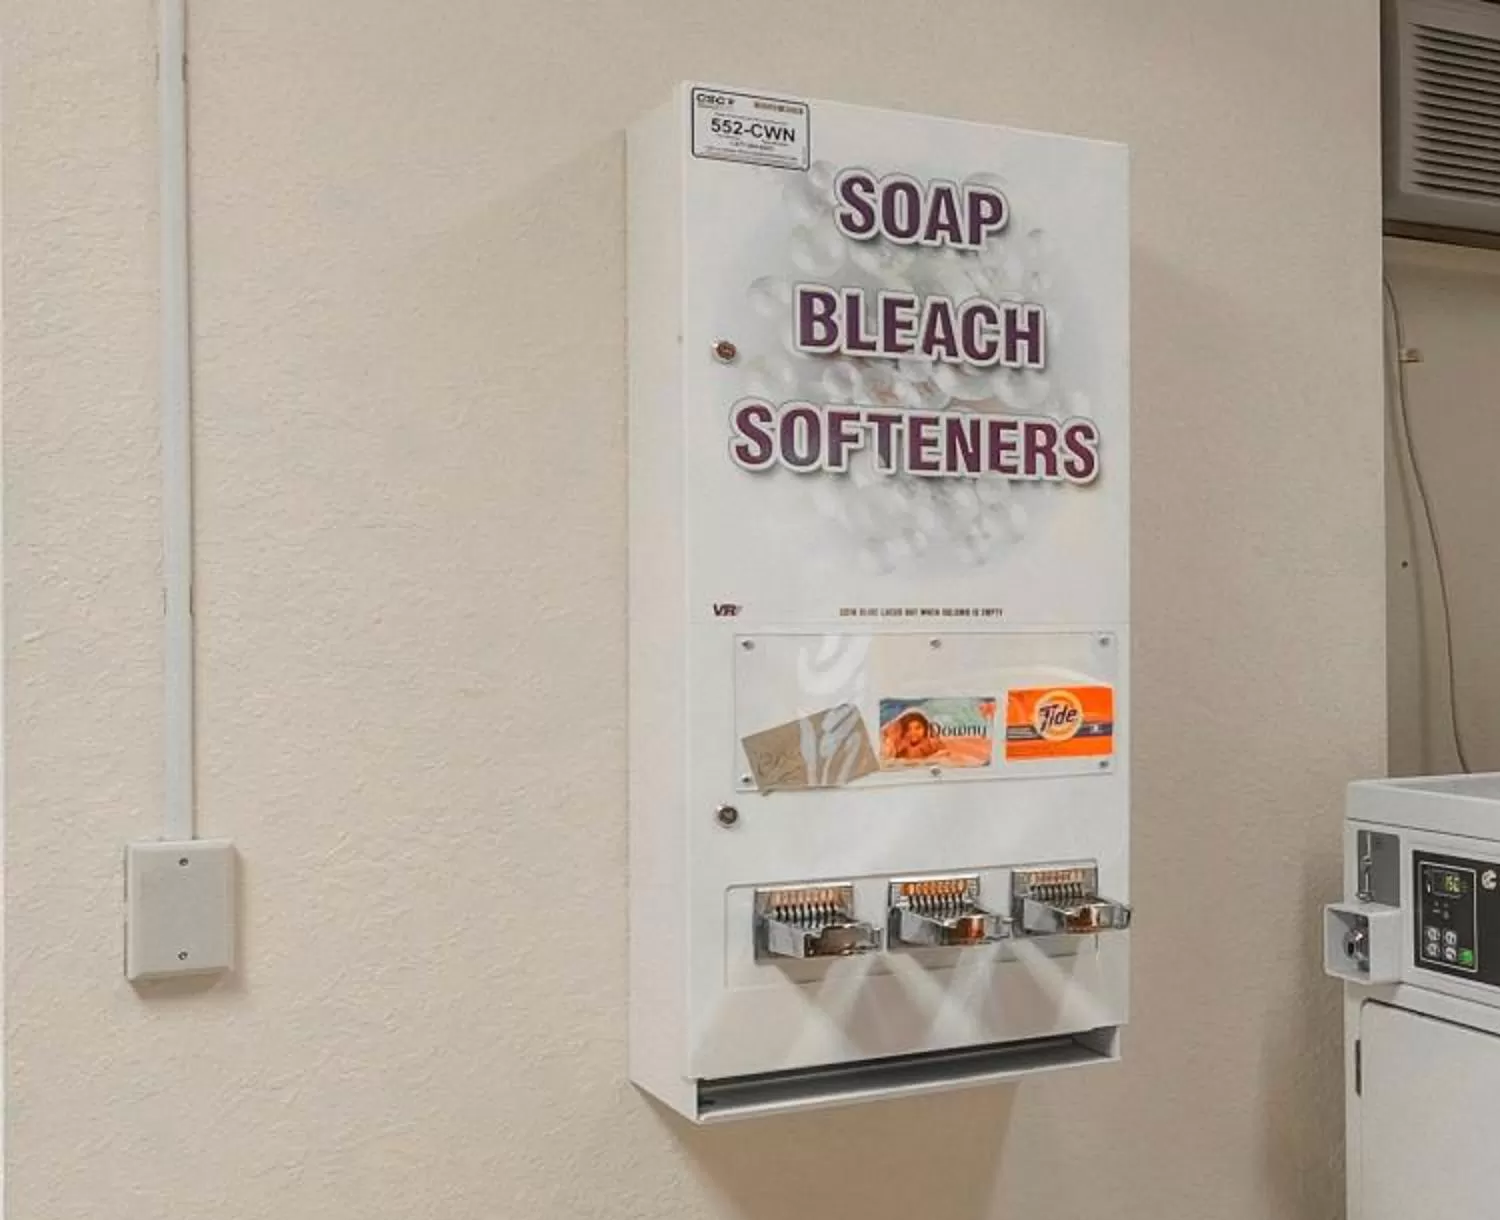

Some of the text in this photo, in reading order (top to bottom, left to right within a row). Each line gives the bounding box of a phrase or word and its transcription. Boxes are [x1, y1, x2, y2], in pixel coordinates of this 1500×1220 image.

[711, 118, 796, 142] 552-CWN
[837, 173, 1004, 247] SOAP
[799, 288, 1043, 366] BLEACH
[733, 403, 1098, 481] SOFTENERS
[929, 721, 987, 739] Downy
[1040, 704, 1078, 732] Tide
